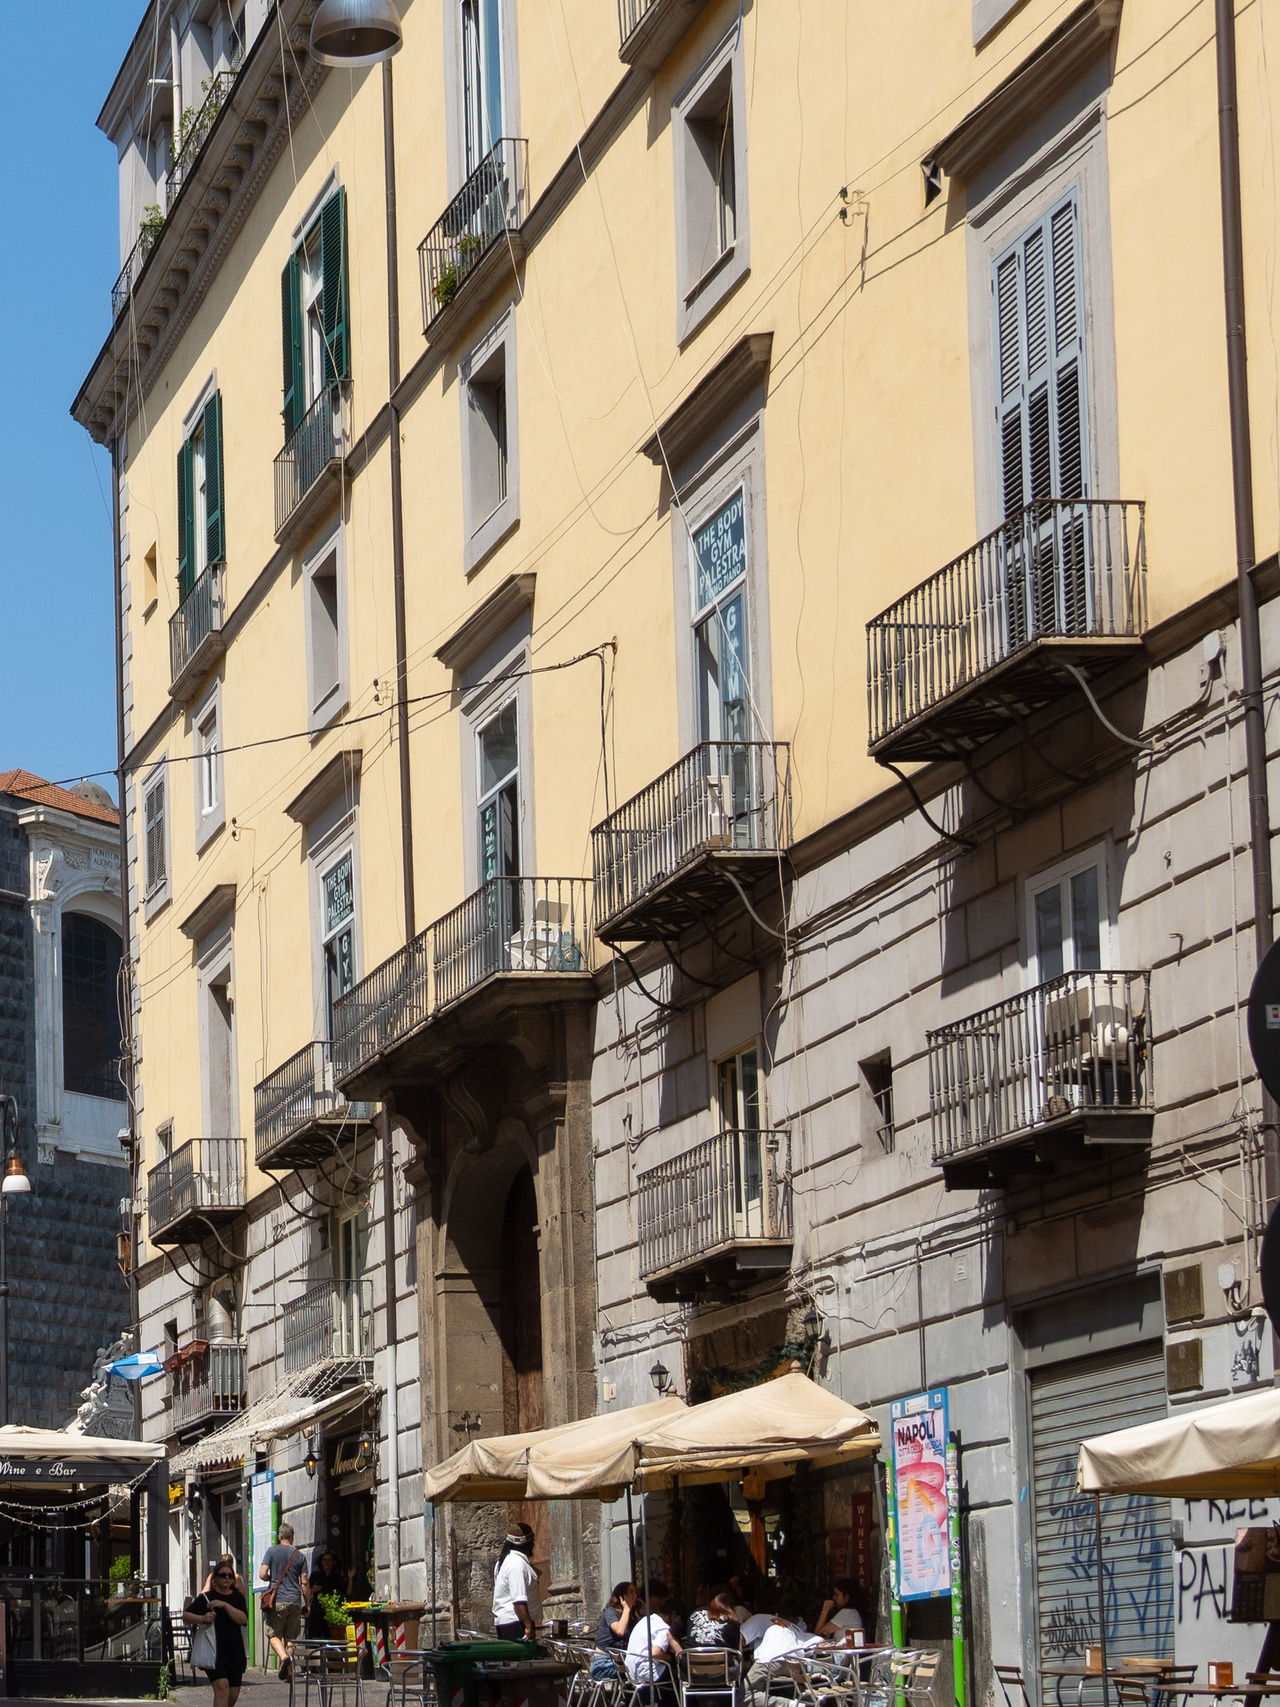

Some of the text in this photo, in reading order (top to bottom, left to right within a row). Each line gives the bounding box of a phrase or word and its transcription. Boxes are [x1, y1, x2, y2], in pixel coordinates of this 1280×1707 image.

[698, 497, 743, 555] THE BODY
[710, 528, 732, 563] GYM
[700, 538, 745, 596] PALESTRA
[724, 563, 741, 585] PIANO
[327, 872, 337, 892] THE
[333, 879, 347, 901] GYM
[897, 1418, 935, 1447] NAPOLI
[35, 1467, 42, 1475] e
[48, 1462, 77, 1477] Bar
[856, 1504, 866, 1549] WINE
